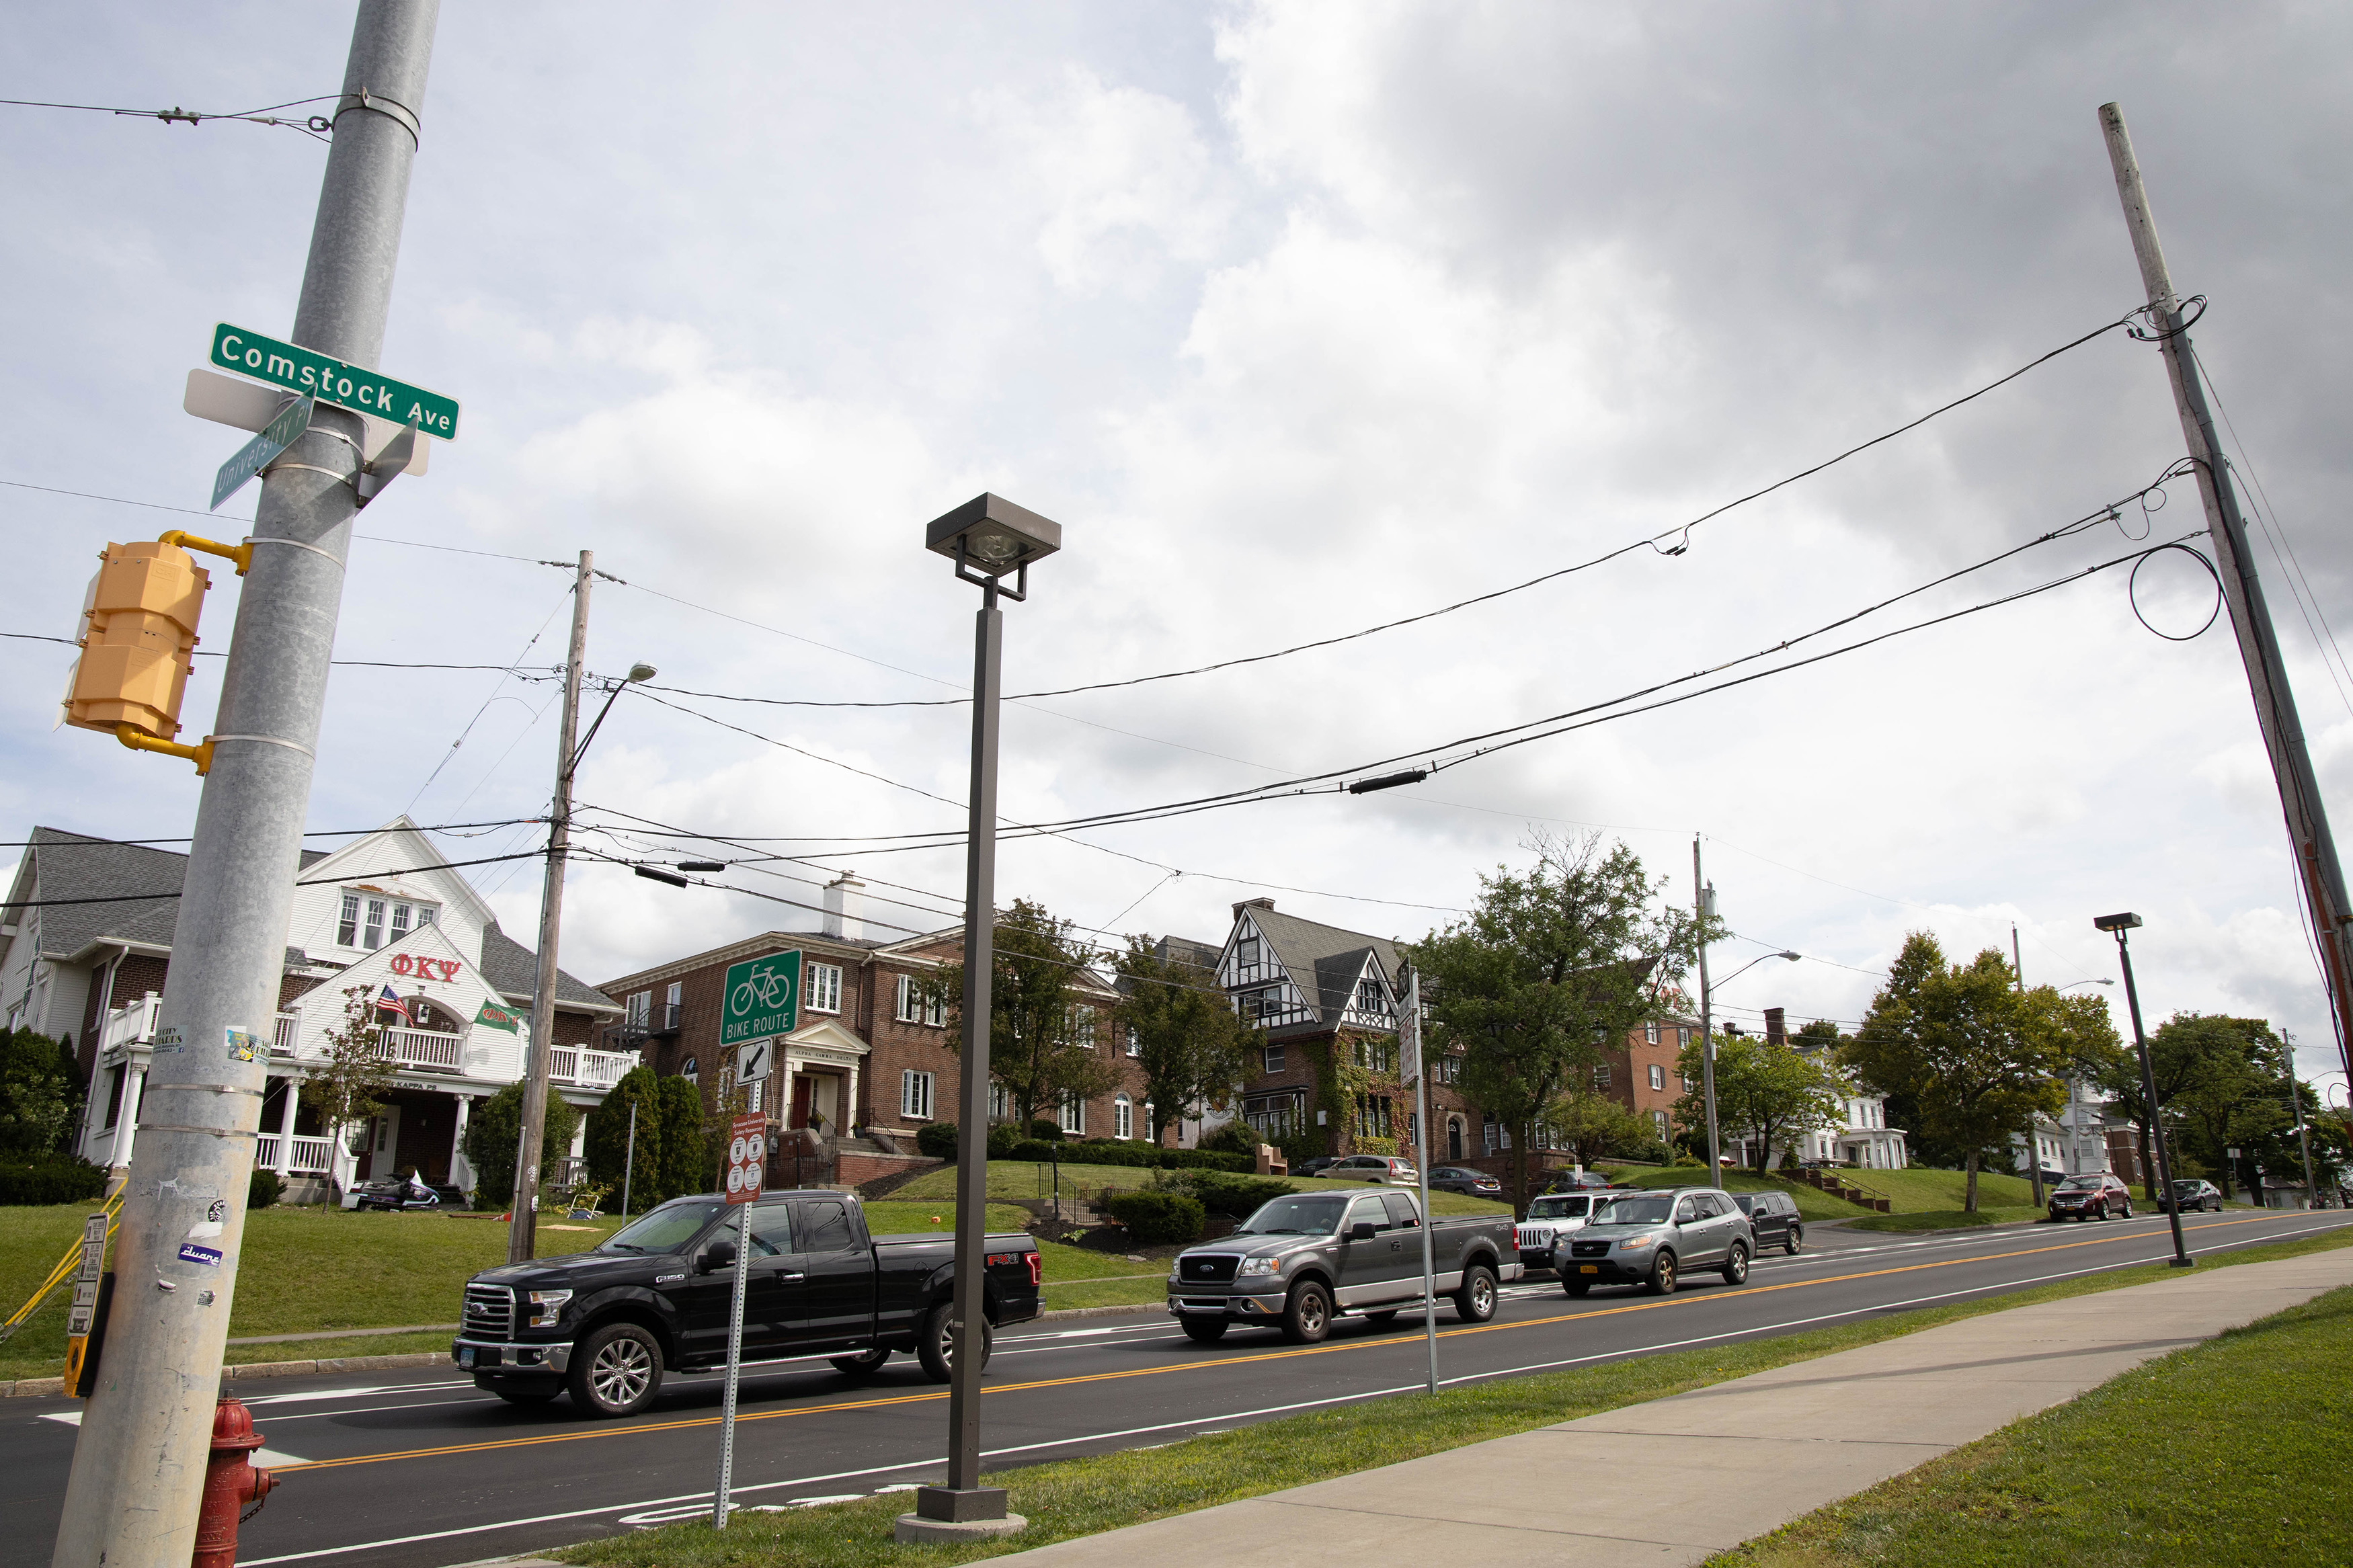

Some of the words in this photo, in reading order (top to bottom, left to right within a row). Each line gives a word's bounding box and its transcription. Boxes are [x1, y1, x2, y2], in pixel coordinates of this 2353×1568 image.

[221, 335, 394, 413] Comstock
[407, 402, 450, 430] Ave
[217, 416, 292, 493] University
[296, 402, 309, 427] Pl
[391, 953, 461, 983] ΦΚΨ
[162, 1028, 178, 1036] CITY
[727, 1020, 750, 1039] BIKE
[753, 1012, 789, 1034] ROUTE
[256, 1046, 270, 1058] BILL
[397, 1081, 424, 1089] KAPPA
[748, 1117, 765, 1125] University
[988, 1253, 1019, 1266] FX4
